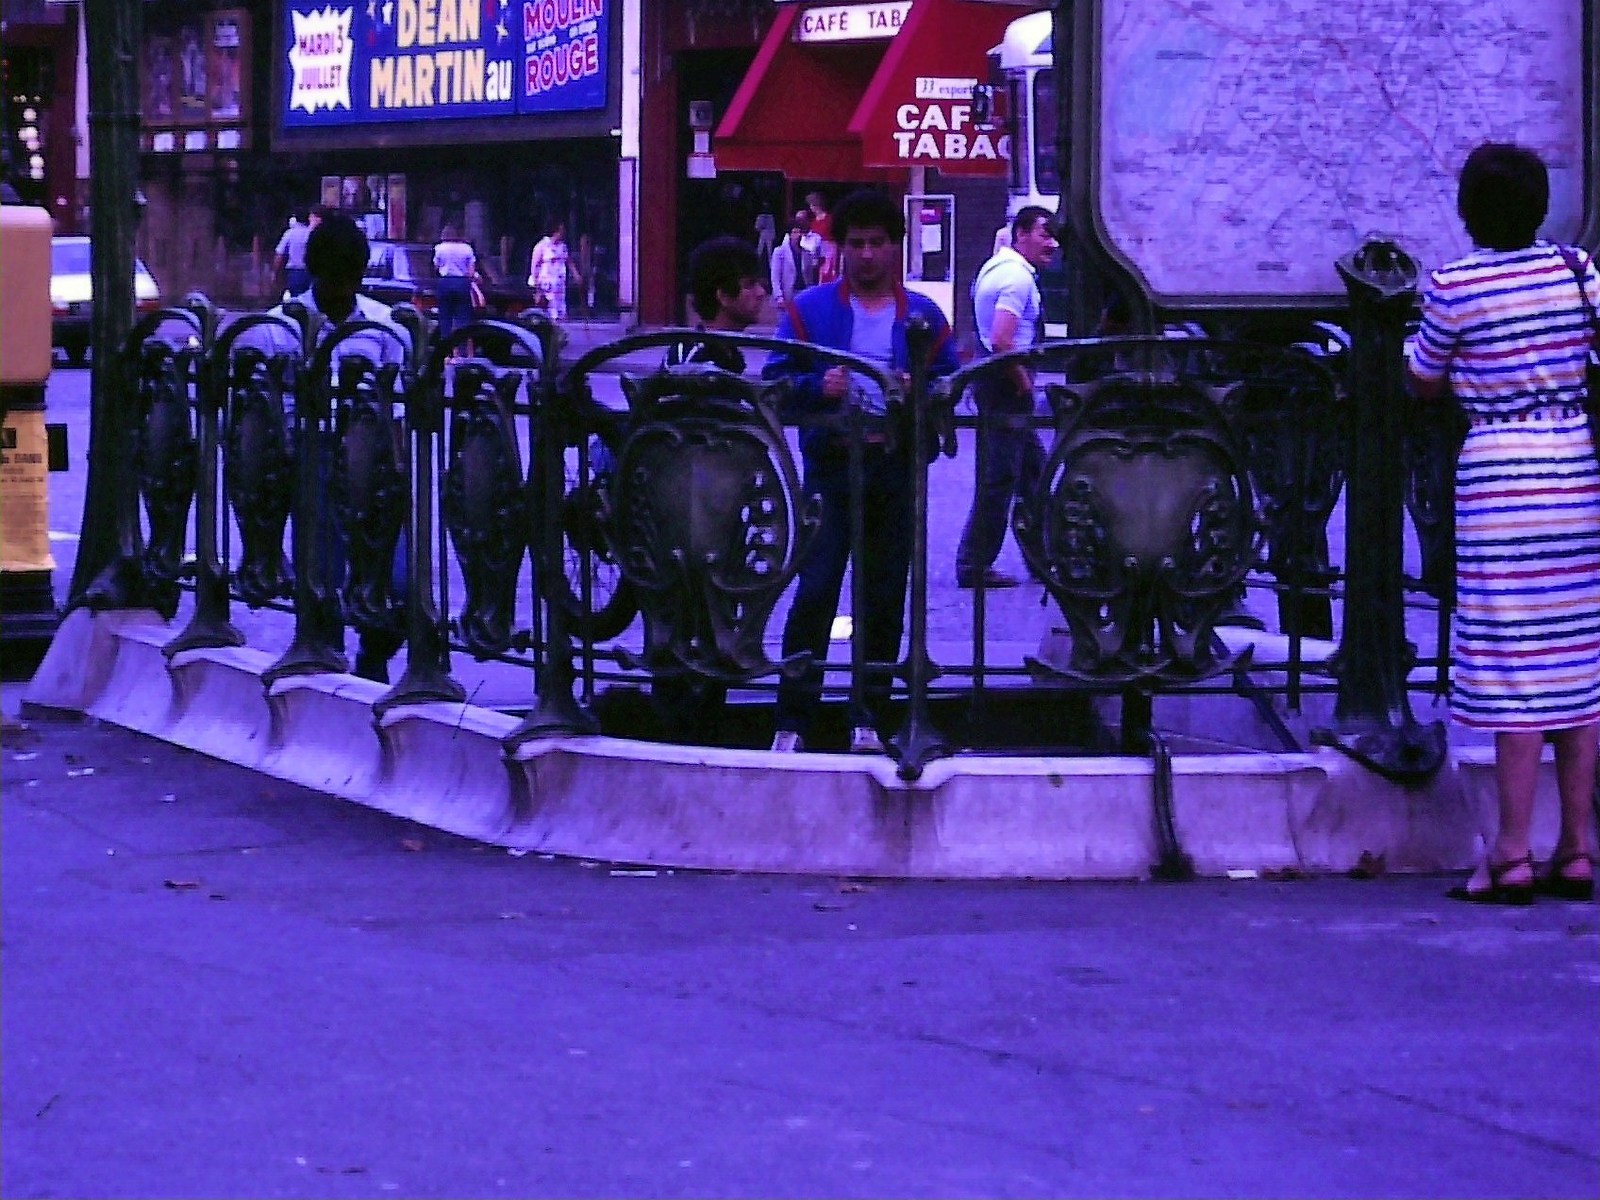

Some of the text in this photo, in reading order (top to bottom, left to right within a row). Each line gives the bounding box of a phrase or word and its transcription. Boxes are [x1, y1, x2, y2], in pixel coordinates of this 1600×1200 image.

[868, 8, 901, 30] TAB
[370, 48, 513, 109] MARTIN au
[525, 32, 599, 96] ROUGE
[896, 104, 995, 131] CAF
